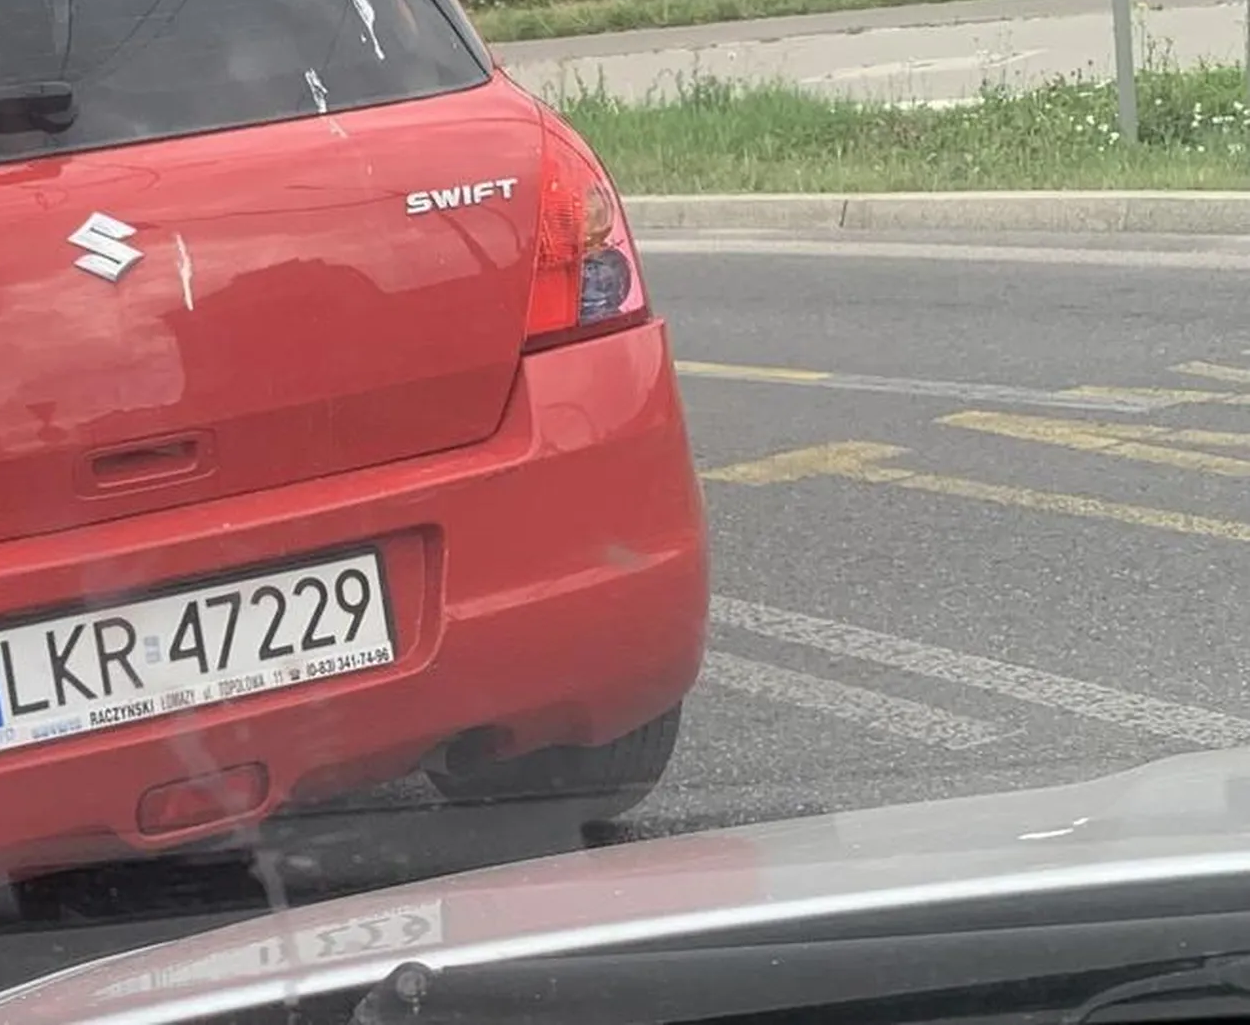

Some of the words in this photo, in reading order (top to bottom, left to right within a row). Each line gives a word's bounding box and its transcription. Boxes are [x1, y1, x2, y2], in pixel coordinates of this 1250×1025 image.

[406, 177, 518, 215] SWIFT
[0, 616, 144, 717] LKR
[168, 568, 371, 674] 47229
